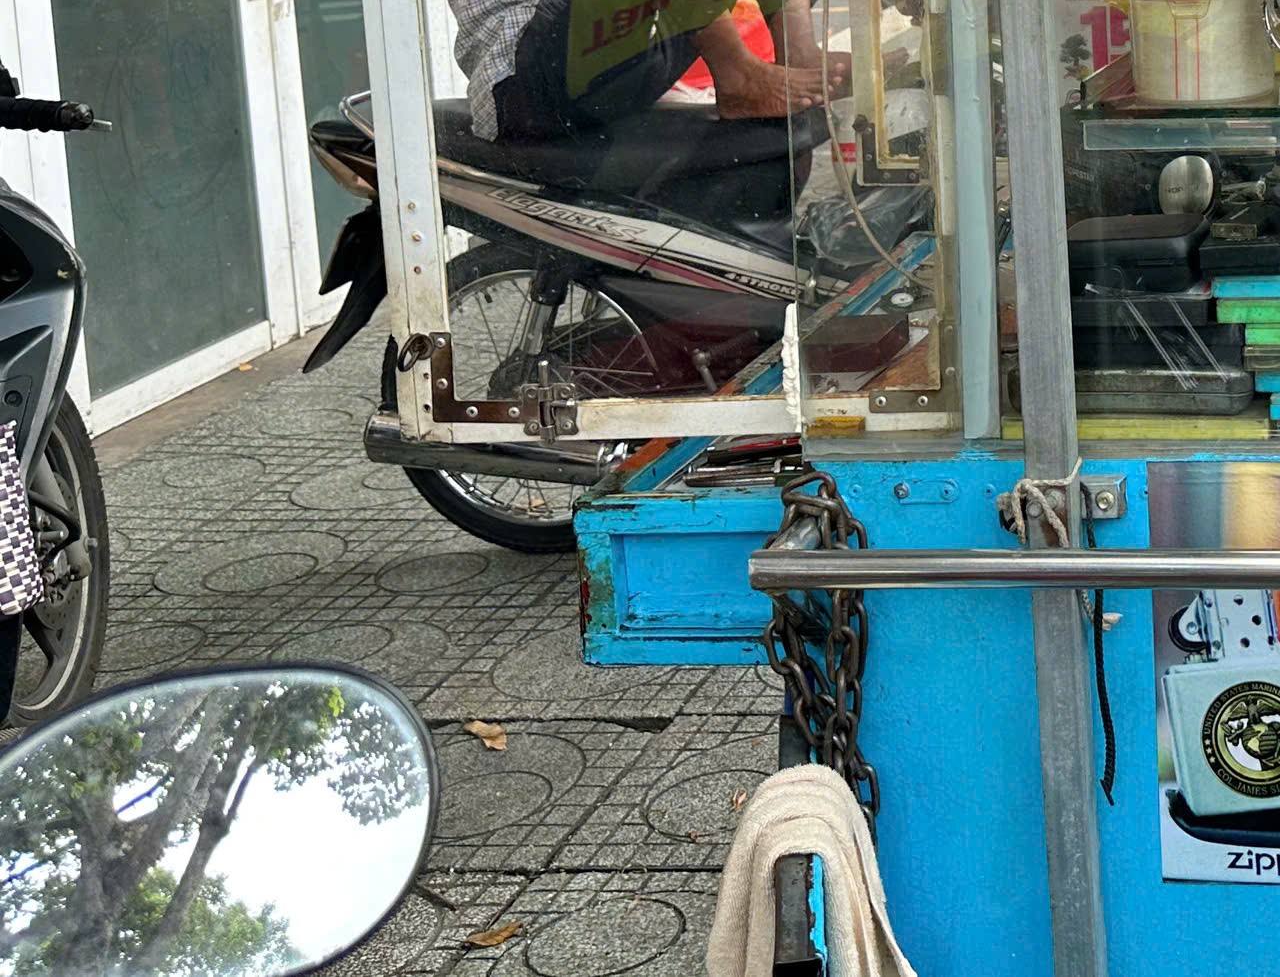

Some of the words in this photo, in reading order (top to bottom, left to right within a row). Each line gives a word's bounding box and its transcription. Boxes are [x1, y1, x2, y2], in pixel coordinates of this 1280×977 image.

[1203, 701, 1222, 735] UNITED
[1222, 684, 1249, 702] STATES
[1234, 781, 1268, 795] JAMES
